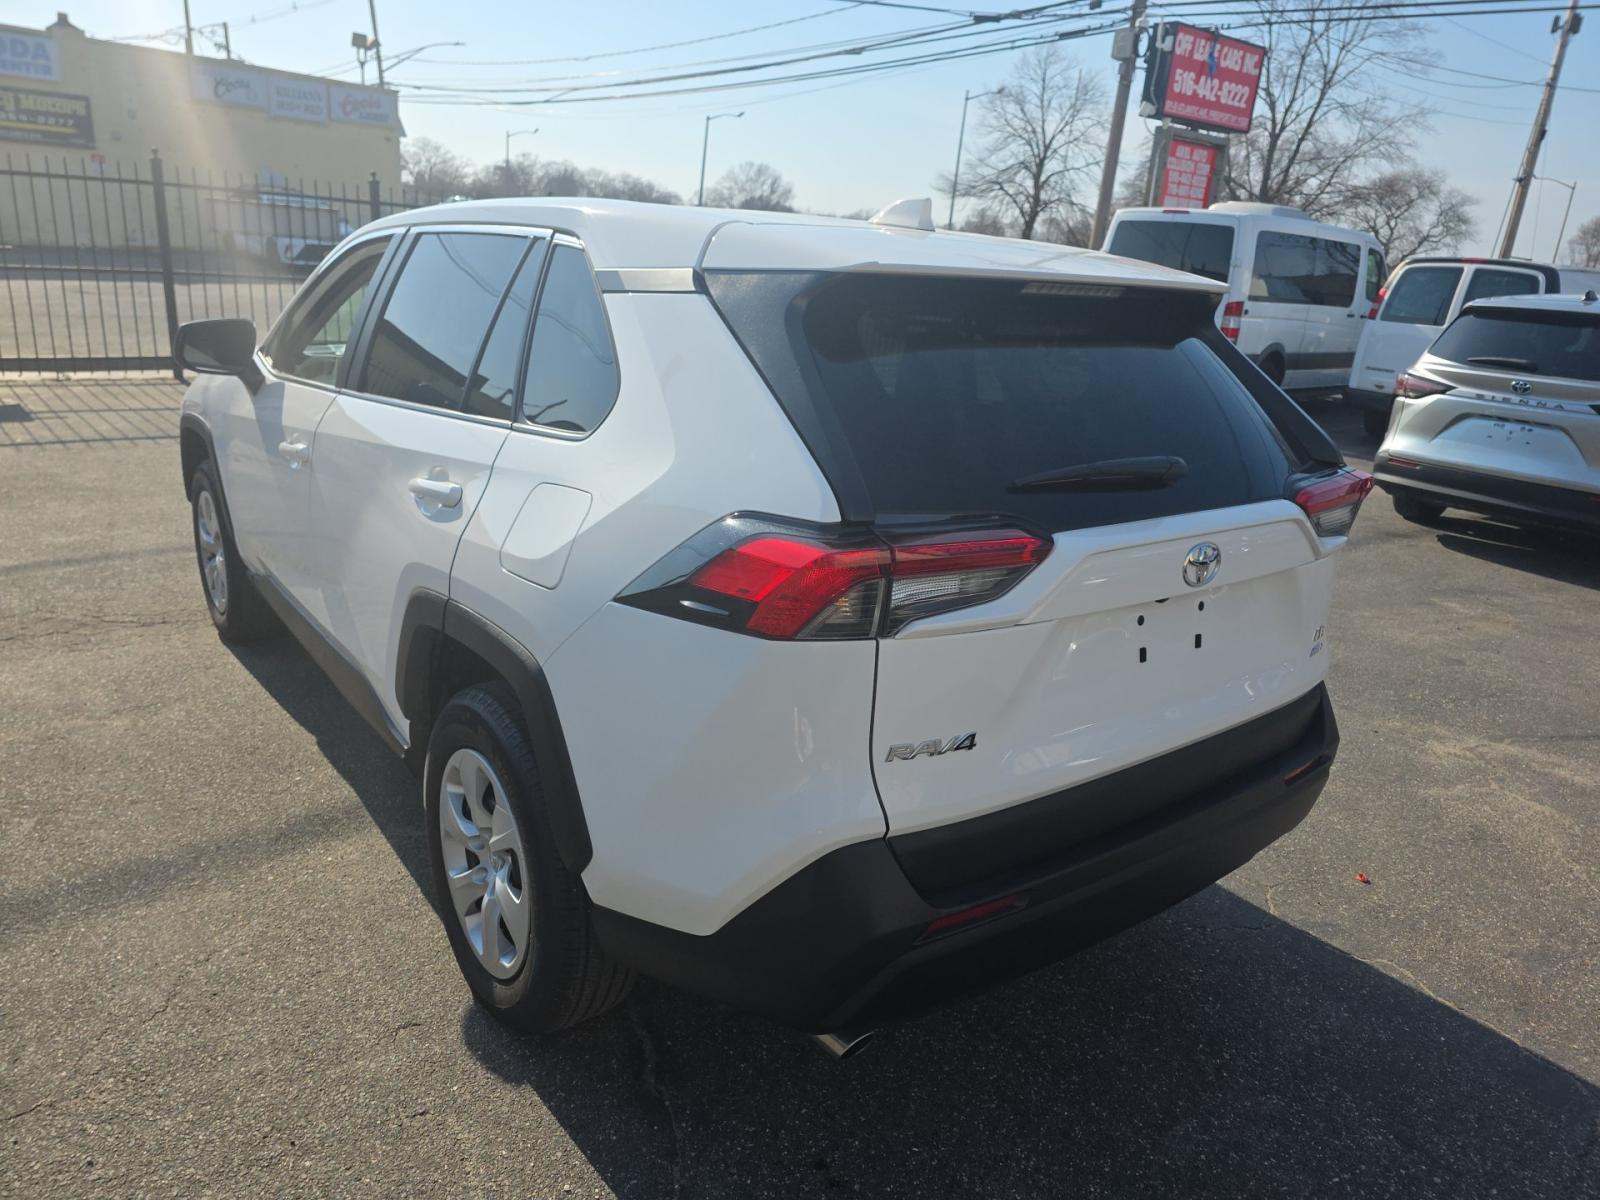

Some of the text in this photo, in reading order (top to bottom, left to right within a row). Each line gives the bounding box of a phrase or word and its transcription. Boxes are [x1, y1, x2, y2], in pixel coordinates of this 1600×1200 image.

[1175, 32, 1194, 57] OFF
[1220, 46, 1244, 72] CARS
[1173, 69, 1250, 108] 516-442-8222
[1475, 393, 1565, 410] SIENNA
[885, 731, 976, 763] RAV4
